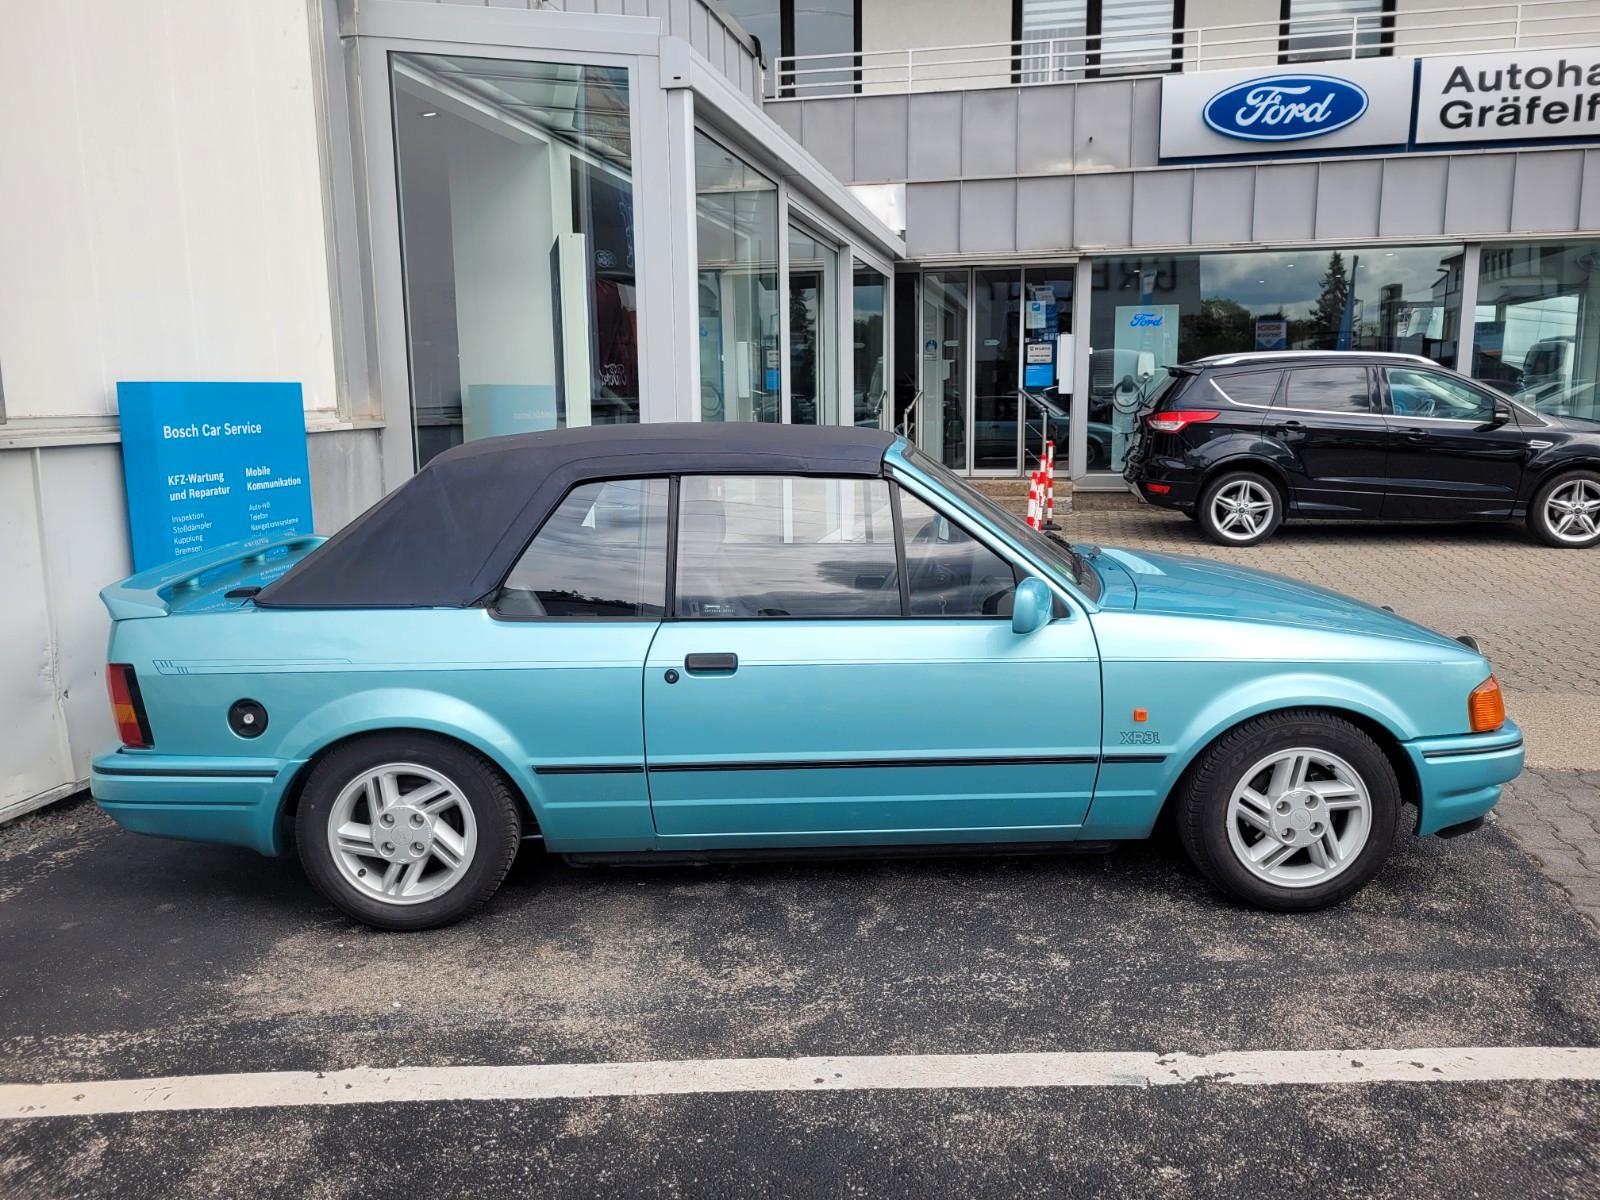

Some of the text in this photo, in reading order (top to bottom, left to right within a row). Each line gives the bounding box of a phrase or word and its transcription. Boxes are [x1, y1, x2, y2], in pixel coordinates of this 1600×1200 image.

[1235, 85, 1336, 126] Ford
[1438, 92, 1600, 129] Gräfelf
[1129, 312, 1163, 328] Ford
[163, 421, 262, 439] Bosch Car Service
[167, 471, 225, 486] KFZ-Wartung
[245, 466, 271, 478] Mobile
[247, 476, 302, 491] Kommunikation
[169, 485, 231, 501] und Reparatur
[171, 511, 205, 524] Inspektion
[249, 511, 269, 521] Telefon
[173, 521, 213, 535] Stoßdämpfer
[174, 534, 204, 547] Kupplung
[174, 545, 203, 556] Bremsen
[1120, 731, 1160, 744] XR3i
